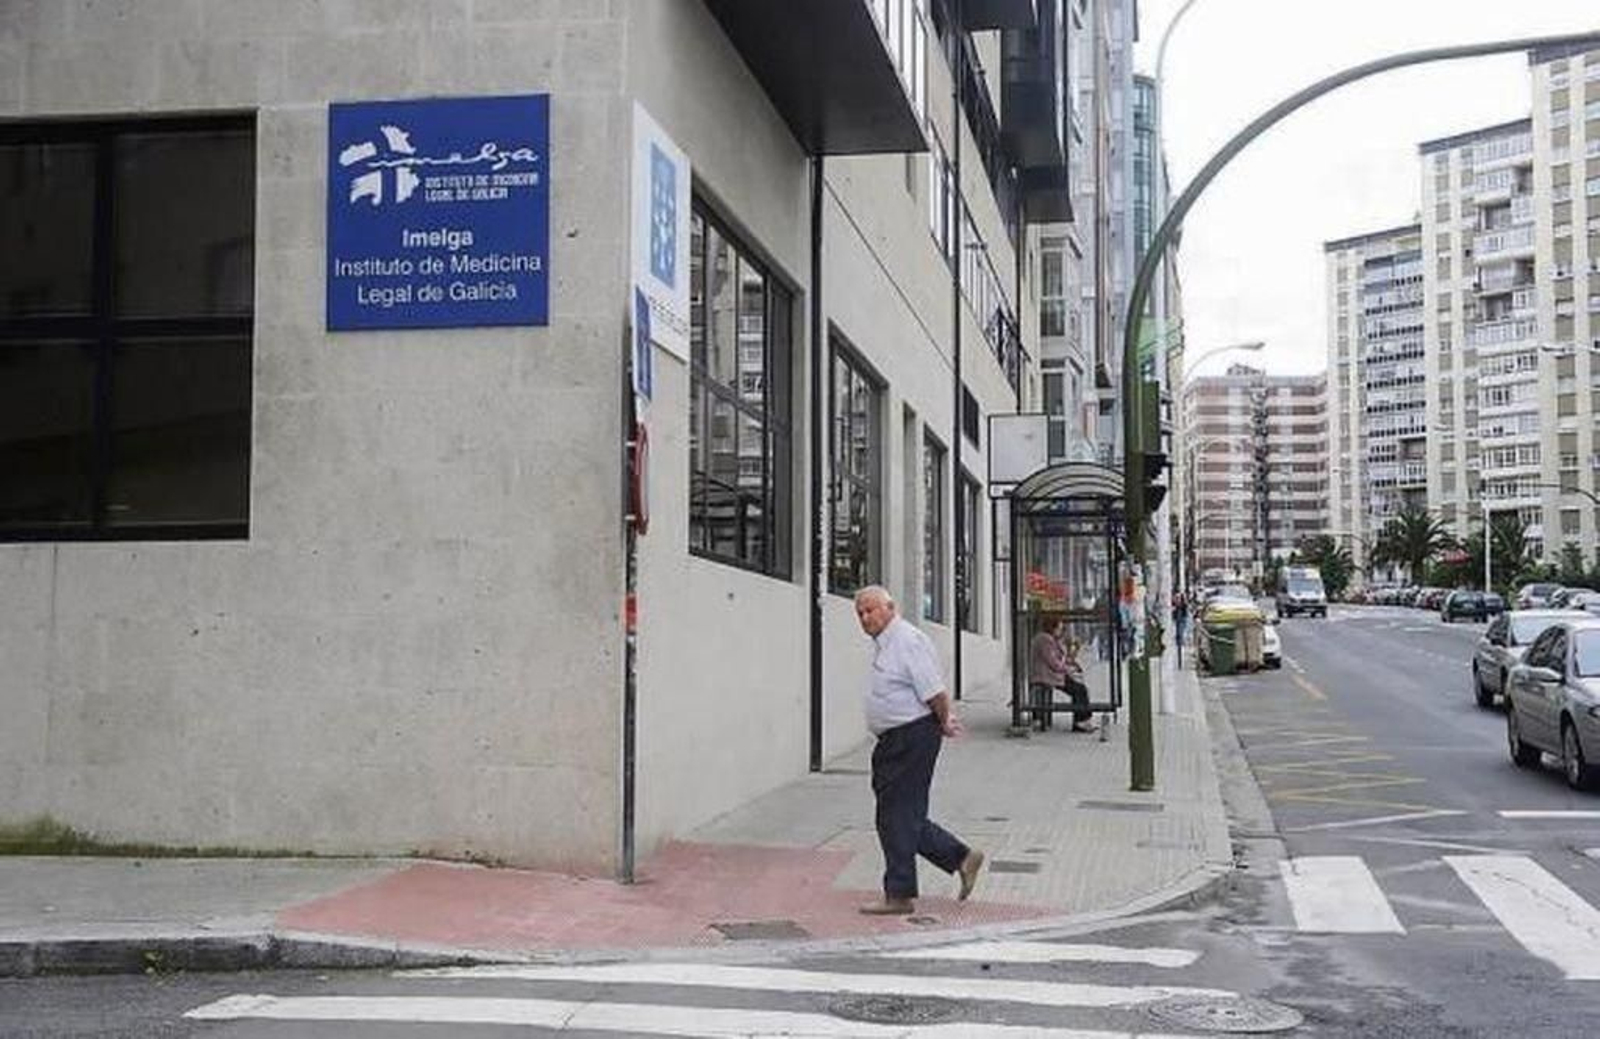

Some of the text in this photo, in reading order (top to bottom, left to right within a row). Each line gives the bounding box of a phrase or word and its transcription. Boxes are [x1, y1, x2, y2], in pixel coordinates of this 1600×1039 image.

[402, 228, 474, 250] Imelga
[335, 253, 541, 277] Instituto de Medicina
[357, 280, 516, 308] Legal de Galicia
